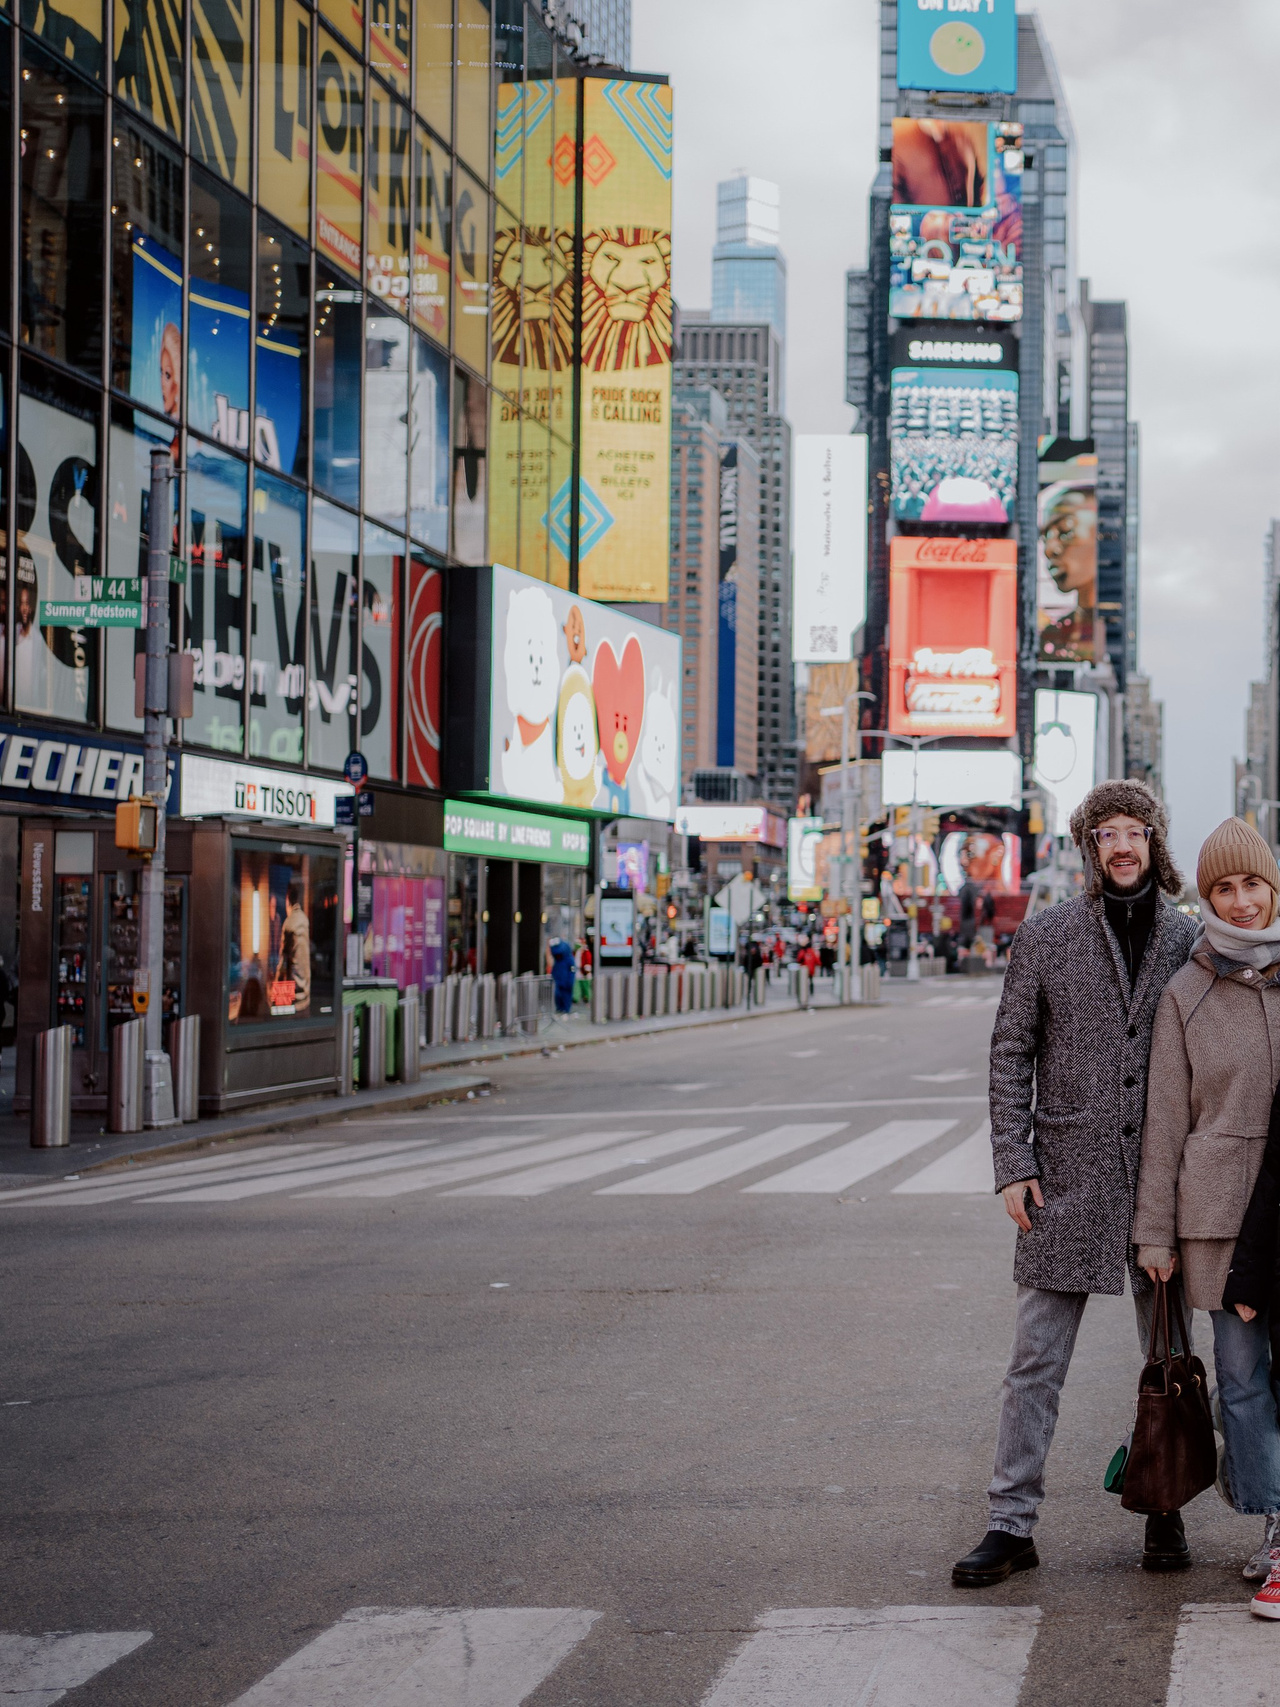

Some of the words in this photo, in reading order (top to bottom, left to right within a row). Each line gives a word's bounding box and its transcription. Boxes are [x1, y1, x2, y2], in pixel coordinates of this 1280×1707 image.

[908, 340, 1003, 363] SAMSUNG
[592, 387, 624, 402] PRIDE
[630, 388, 661, 404] ROCK
[603, 406, 661, 424] CALLING
[92, 579, 104, 599] W
[107, 581, 127, 600] 44
[130, 579, 140, 592] St
[45, 602, 87, 618] Sumner
[90, 602, 138, 619] Redstone
[0, 732, 175, 803] ECHER
[444, 814, 462, 836] POP
[464, 817, 495, 841] SQUARE
[498, 822, 508, 842] BY
[32, 842, 44, 912] Newsstand
